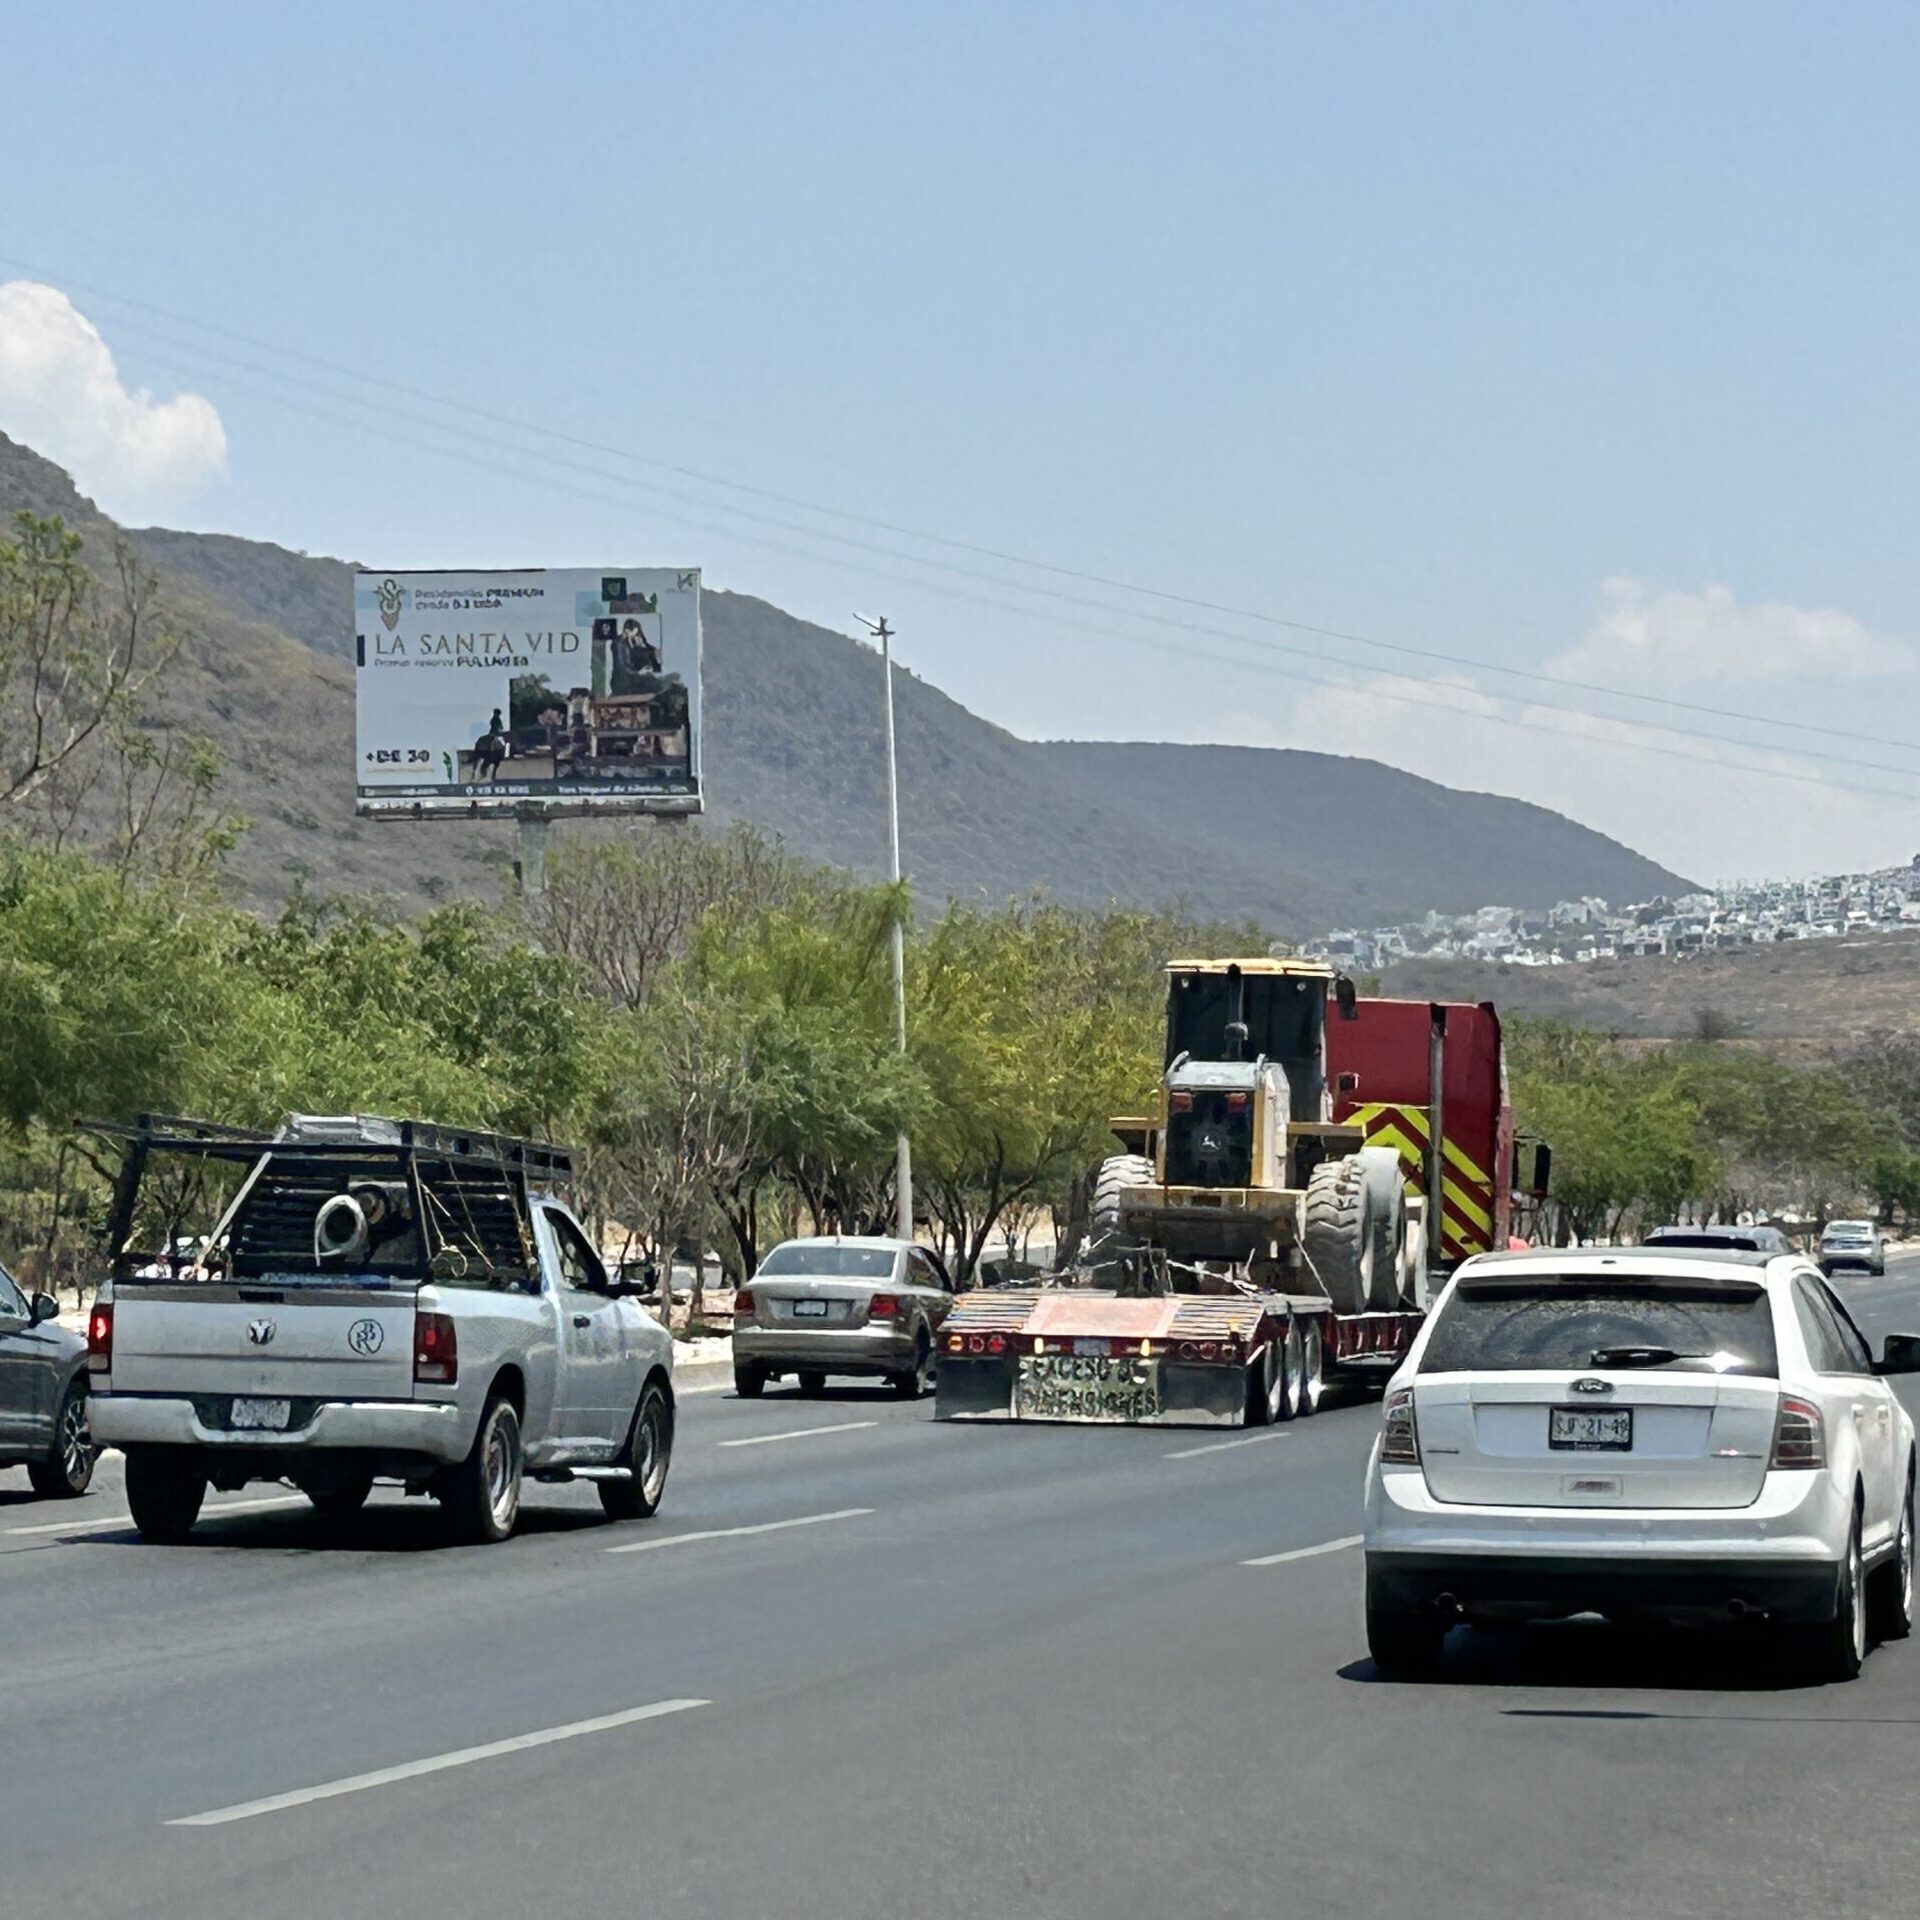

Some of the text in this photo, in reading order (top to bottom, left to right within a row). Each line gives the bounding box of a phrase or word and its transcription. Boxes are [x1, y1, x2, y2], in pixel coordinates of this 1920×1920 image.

[376, 631, 580, 655] LA SANTA VID
